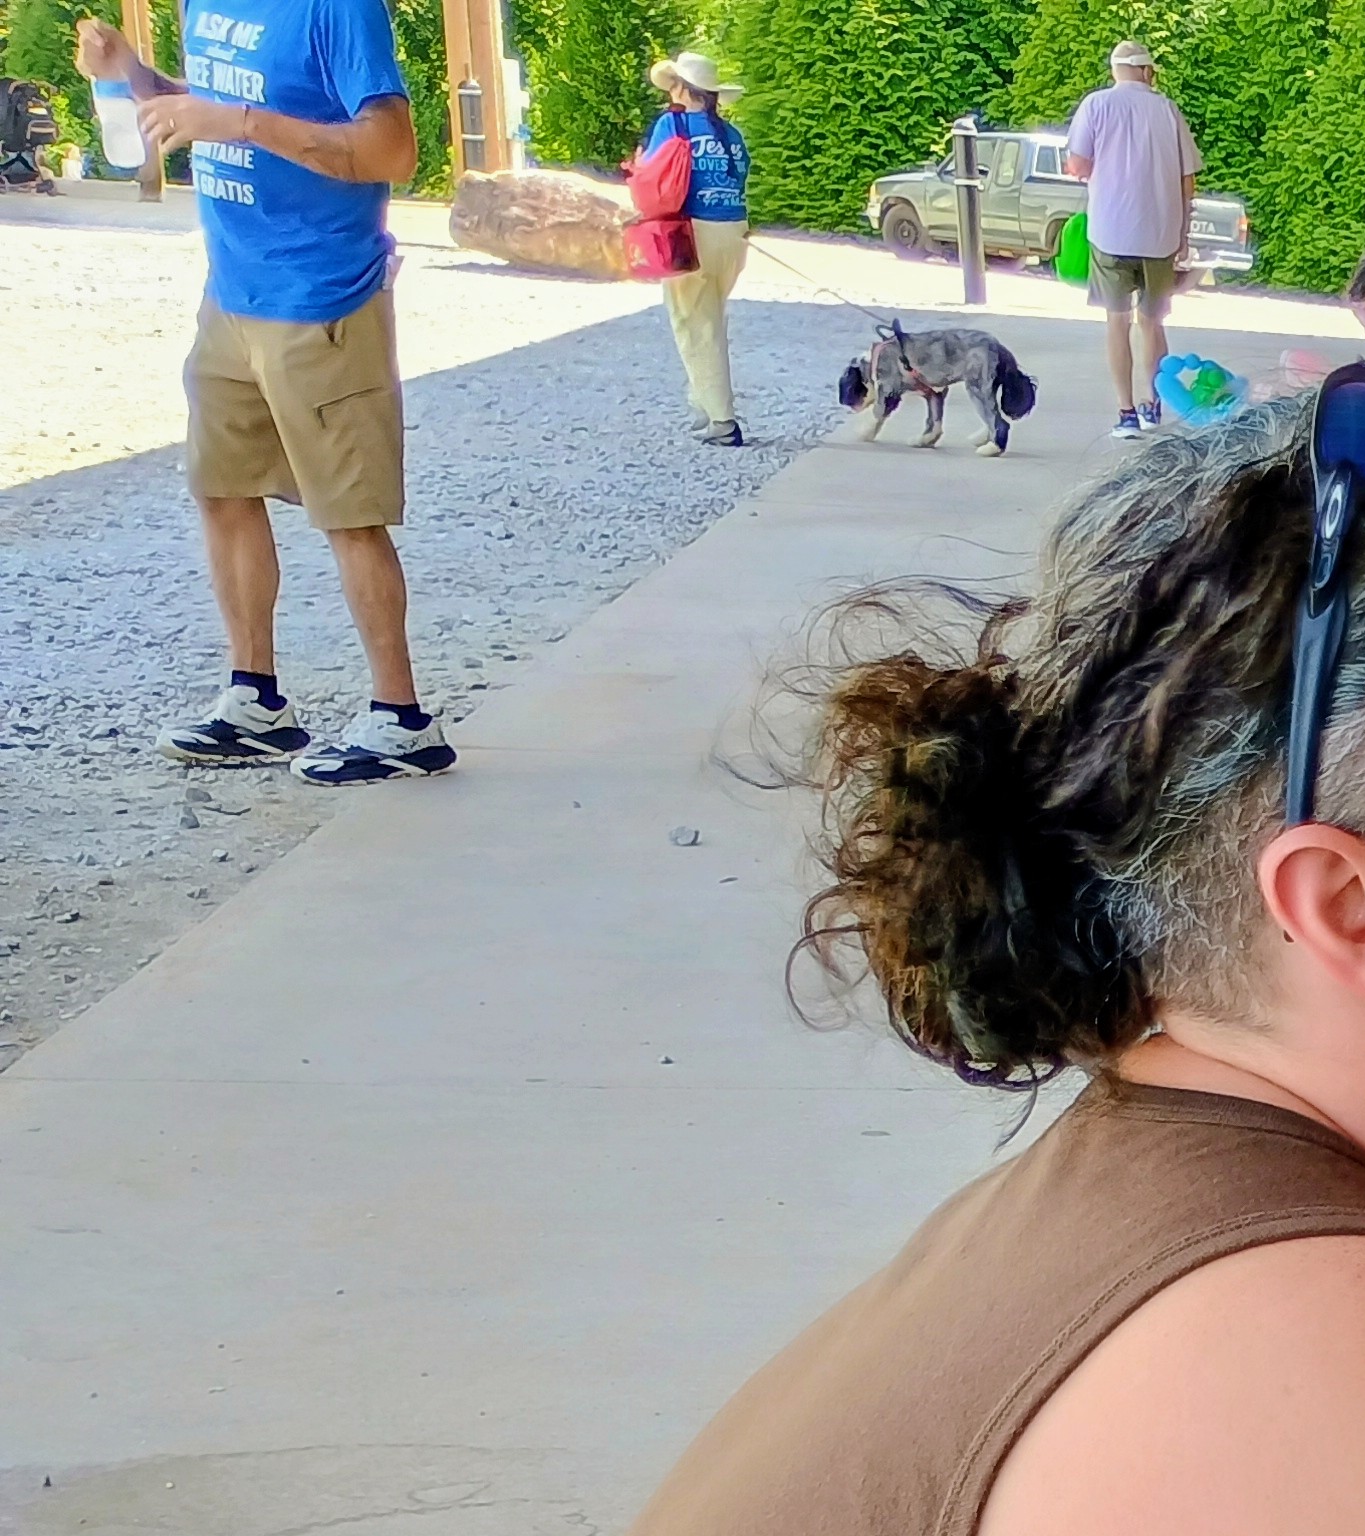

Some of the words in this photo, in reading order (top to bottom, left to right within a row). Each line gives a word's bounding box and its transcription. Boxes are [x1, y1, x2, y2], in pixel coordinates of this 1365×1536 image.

[230, 20, 265, 51] ME
[212, 60, 266, 104] WATER
[691, 158, 729, 172] LOVES
